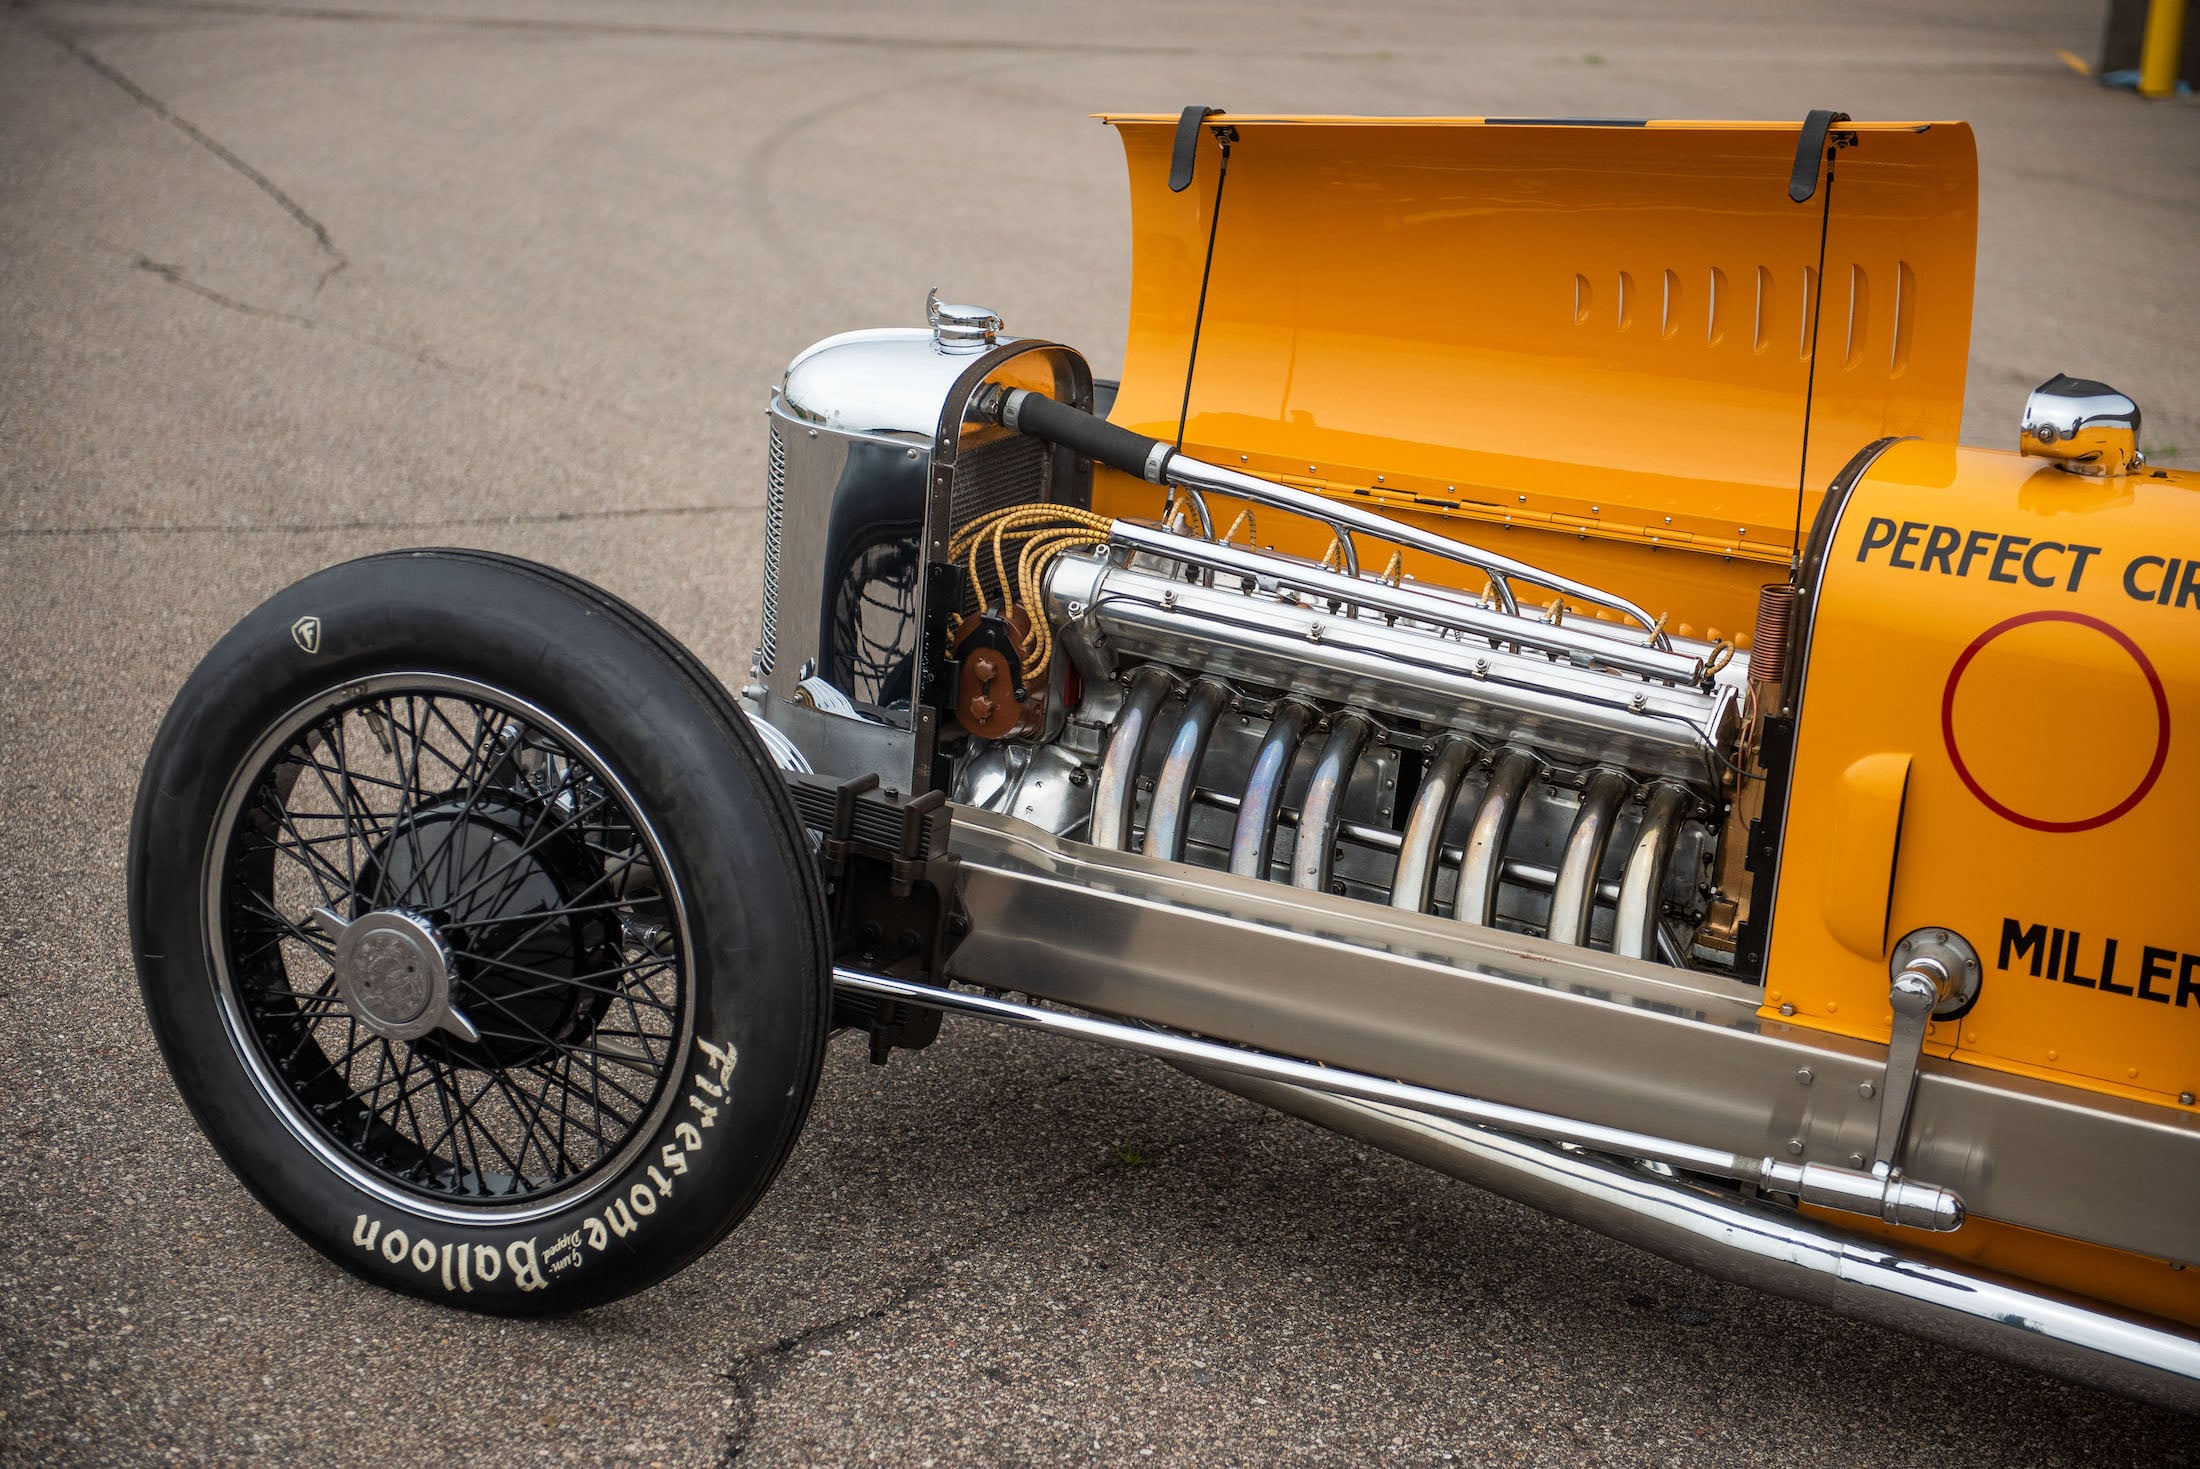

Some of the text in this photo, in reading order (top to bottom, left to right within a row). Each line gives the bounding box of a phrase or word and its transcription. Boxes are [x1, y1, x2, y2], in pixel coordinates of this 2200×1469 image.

[1856, 516, 2200, 611] PERFECT CIR
[1997, 917, 2200, 1009] MILLER
[352, 1035, 738, 1293] Firestone Balloon
[541, 1230, 583, 1265] Dipped
